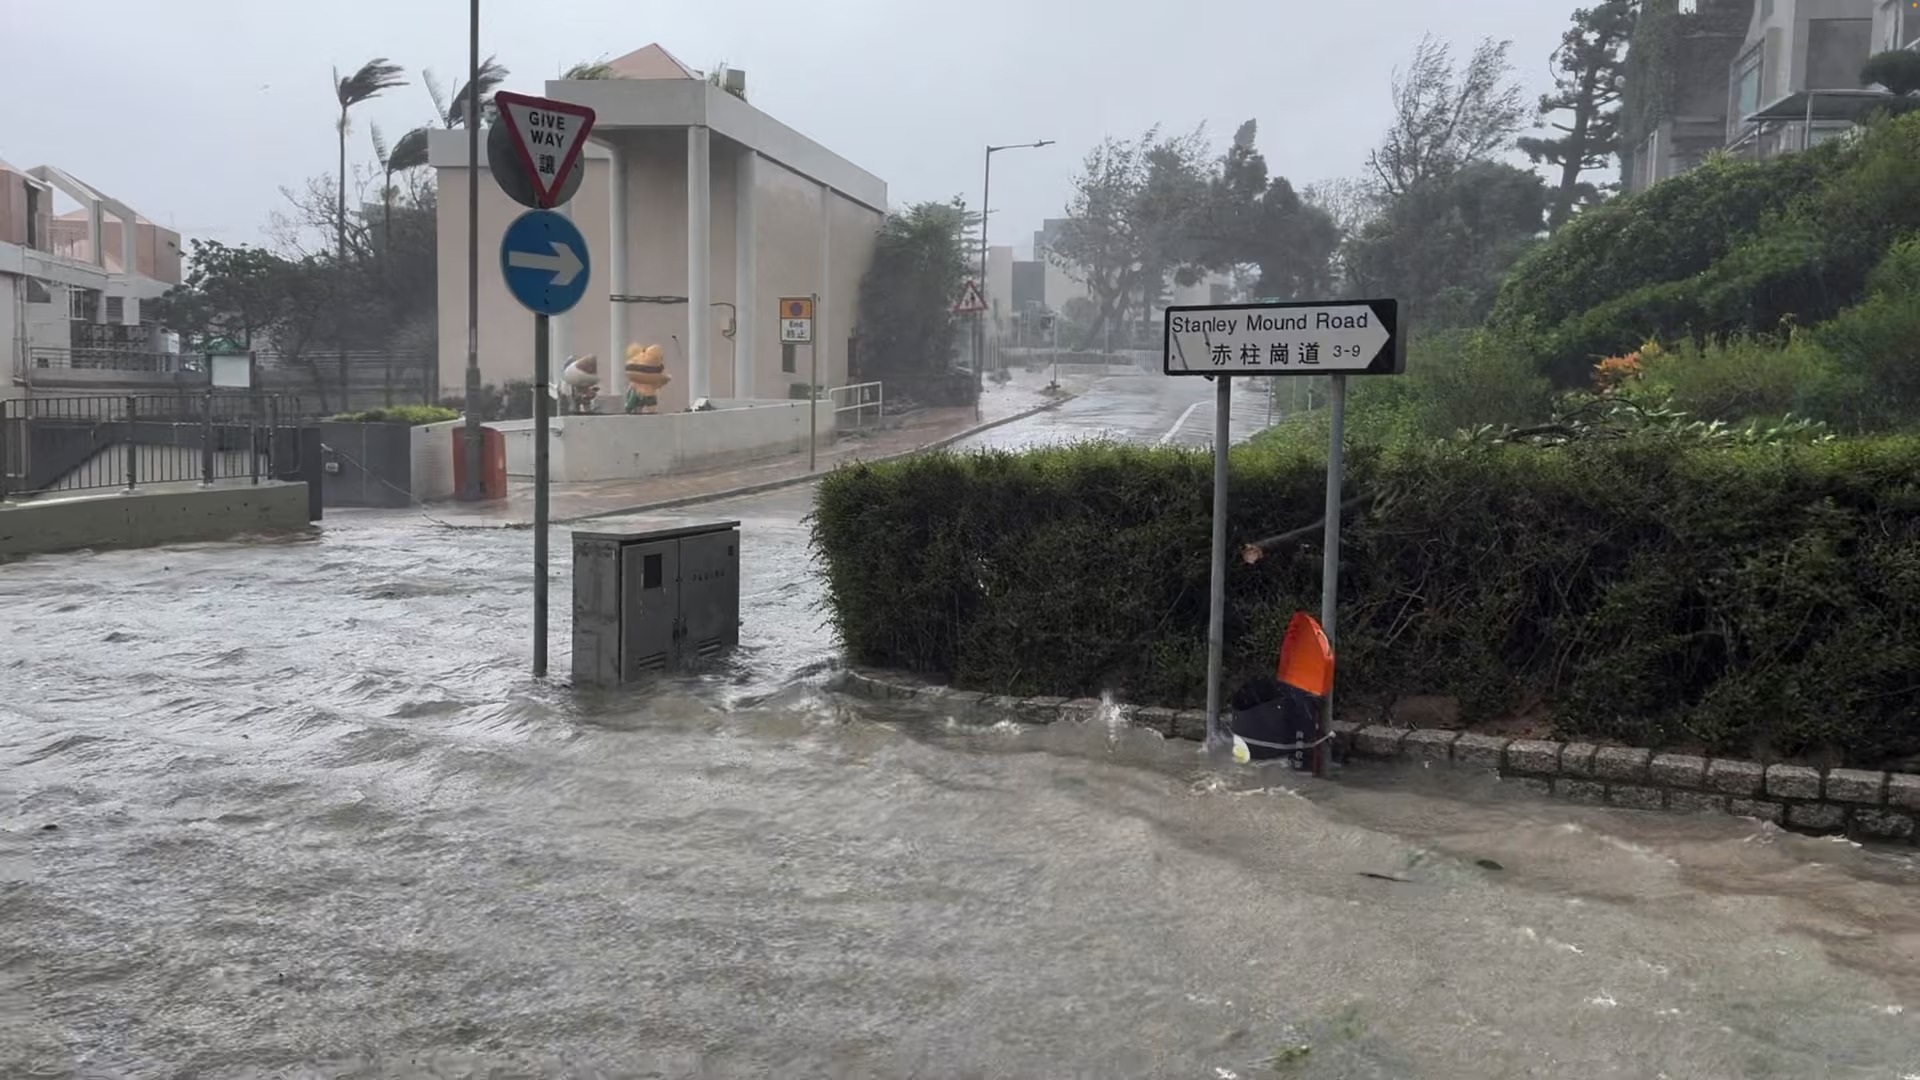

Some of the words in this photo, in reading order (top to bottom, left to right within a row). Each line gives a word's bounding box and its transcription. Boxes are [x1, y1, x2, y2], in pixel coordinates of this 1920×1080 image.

[529, 111, 566, 130] GIVE
[530, 129, 565, 149] WAY
[1171, 316, 1237, 335] Stanley
[1247, 314, 1307, 332] Mound
[1316, 312, 1368, 329] Road
[1212, 342, 1320, 366] 赤柱崗道
[1333, 344, 1361, 358] 3-9
